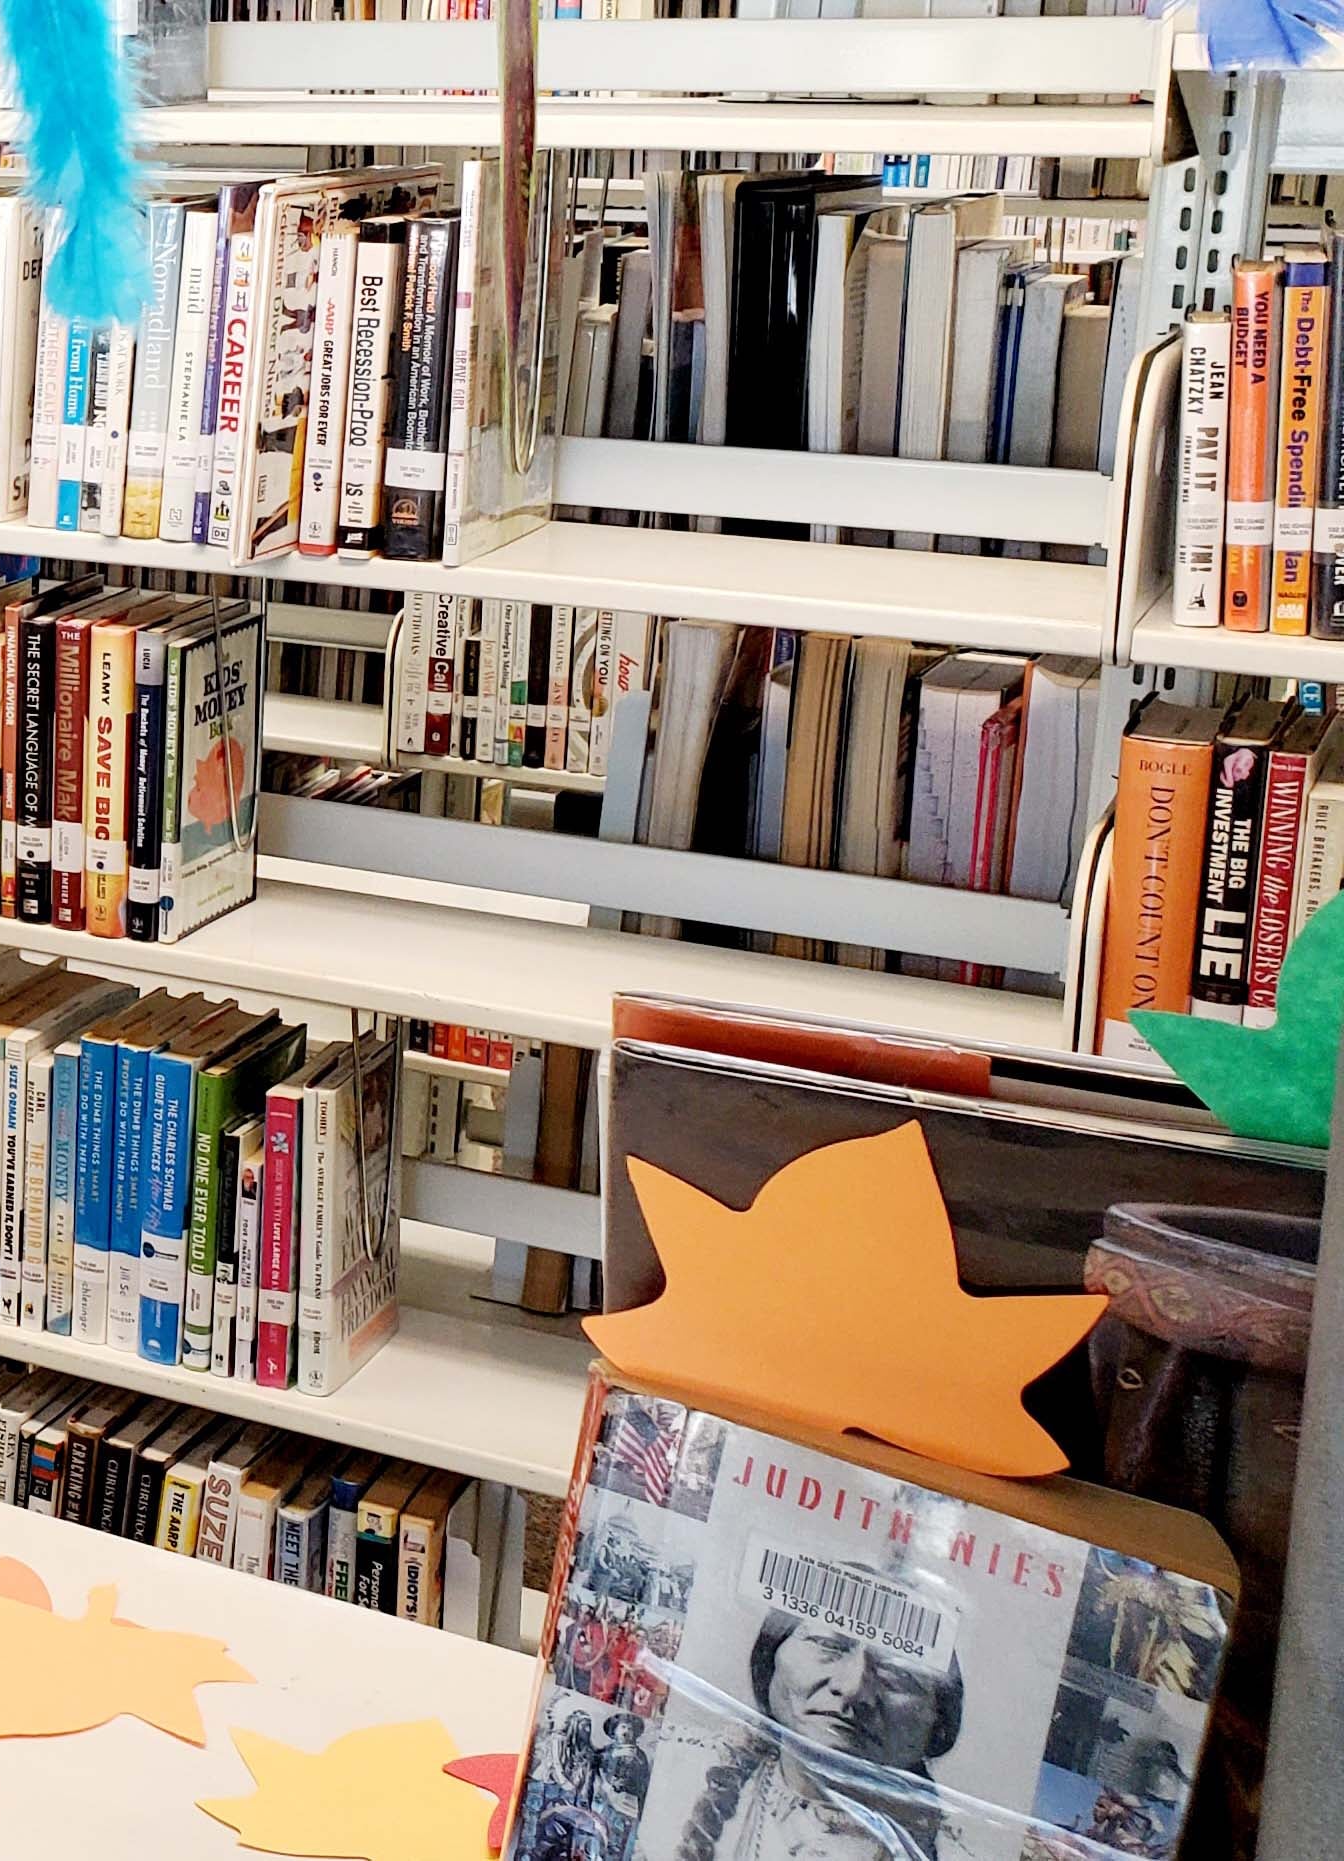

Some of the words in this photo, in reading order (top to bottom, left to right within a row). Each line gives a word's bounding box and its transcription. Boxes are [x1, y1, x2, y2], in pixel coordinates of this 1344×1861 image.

[187, 267, 204, 316] maid
[361, 276, 383, 317] Best
[1254, 291, 1269, 320] YOU
[1299, 291, 1313, 314] The
[73, 334, 89, 375] from
[323, 340, 335, 368] GREAT
[1234, 306, 1250, 369] BUDGET
[1253, 325, 1268, 368] NEED
[180, 351, 194, 423] STEPHANIE
[219, 316, 247, 434] CAREER
[320, 368, 332, 399] JOBS
[1186, 346, 1207, 415] CHATZKY
[1209, 360, 1225, 400] JEAN
[1251, 372, 1262, 385] A
[1291, 316, 1315, 422] Debt-Free
[67, 376, 85, 418] Home
[1197, 427, 1219, 468] PAY
[1195, 470, 1216, 492] IT
[61, 631, 81, 641] THE
[435, 594, 454, 657] Creative
[27, 634, 41, 658] THE
[142, 648, 151, 670] LUCIA
[26, 661, 40, 711] SECRET
[102, 652, 112, 706] LEAMY
[433, 660, 449, 693] Call
[598, 653, 610, 685] YOU
[618, 653, 640, 694] how
[58, 645, 81, 763] Millionaire
[24, 713, 40, 785] LANGUAGE
[96, 715, 113, 795] SAVE
[1139, 758, 1192, 776] BOGLE
[24, 786, 39, 808] OF
[1144, 786, 1175, 862] DON'T
[1231, 818, 1252, 851] THE
[1270, 781, 1300, 870] WINNING
[1316, 804, 1329, 831] RULE
[1205, 786, 1234, 904] INVESTMENT
[1227, 857, 1247, 890] BIG
[1265, 872, 1288, 905] the
[1137, 864, 1170, 957] COUNT
[1198, 906, 1247, 982] LIE
[1254, 906, 1287, 984] LOSER'S
[8, 1064, 18, 1088] SUZE
[155, 1074, 165, 1106] GUIDE
[7, 1091, 17, 1130] ORMAN
[36, 1091, 46, 1113] CARL
[93, 1093, 102, 1123] DUMB
[318, 1100, 328, 1137] TOOHEY
[5, 1135, 16, 1170] YOU'VE
[91, 1127, 101, 1166] THINGS
[151, 1123, 162, 1180] FINANCES
[166, 1119, 177, 1163] CHARLES
[198, 1132, 211, 1152] NO
[163, 1166, 175, 1212] SCHWAB
[197, 1156, 210, 1188] ONE
[3, 1171, 15, 1214] EARNED
[194, 1188, 209, 1226] EVER
[192, 1227, 207, 1260] TOLD
[67, 1441, 87, 1500] CRACKING
[106, 1458, 119, 1494] CHRIS
[172, 1492, 185, 1514] THE
[199, 1474, 232, 1562] SUZE
[167, 1516, 181, 1549] AARP
[284, 1521, 301, 1556] MEET
[733, 1456, 914, 1545] JUDITH
[949, 1530, 1065, 1598] NIES
[799, 1554, 816, 1565] SAN
[817, 1559, 842, 1574] DIEGO
[844, 1570, 873, 1588] PUBLIC
[874, 1583, 908, 1600] LIBRARY
[762, 1586, 774, 1601] 3
[781, 1593, 820, 1618] 1336
[824, 1610, 877, 1640] 04159
[882, 1630, 925, 1658] 5084
